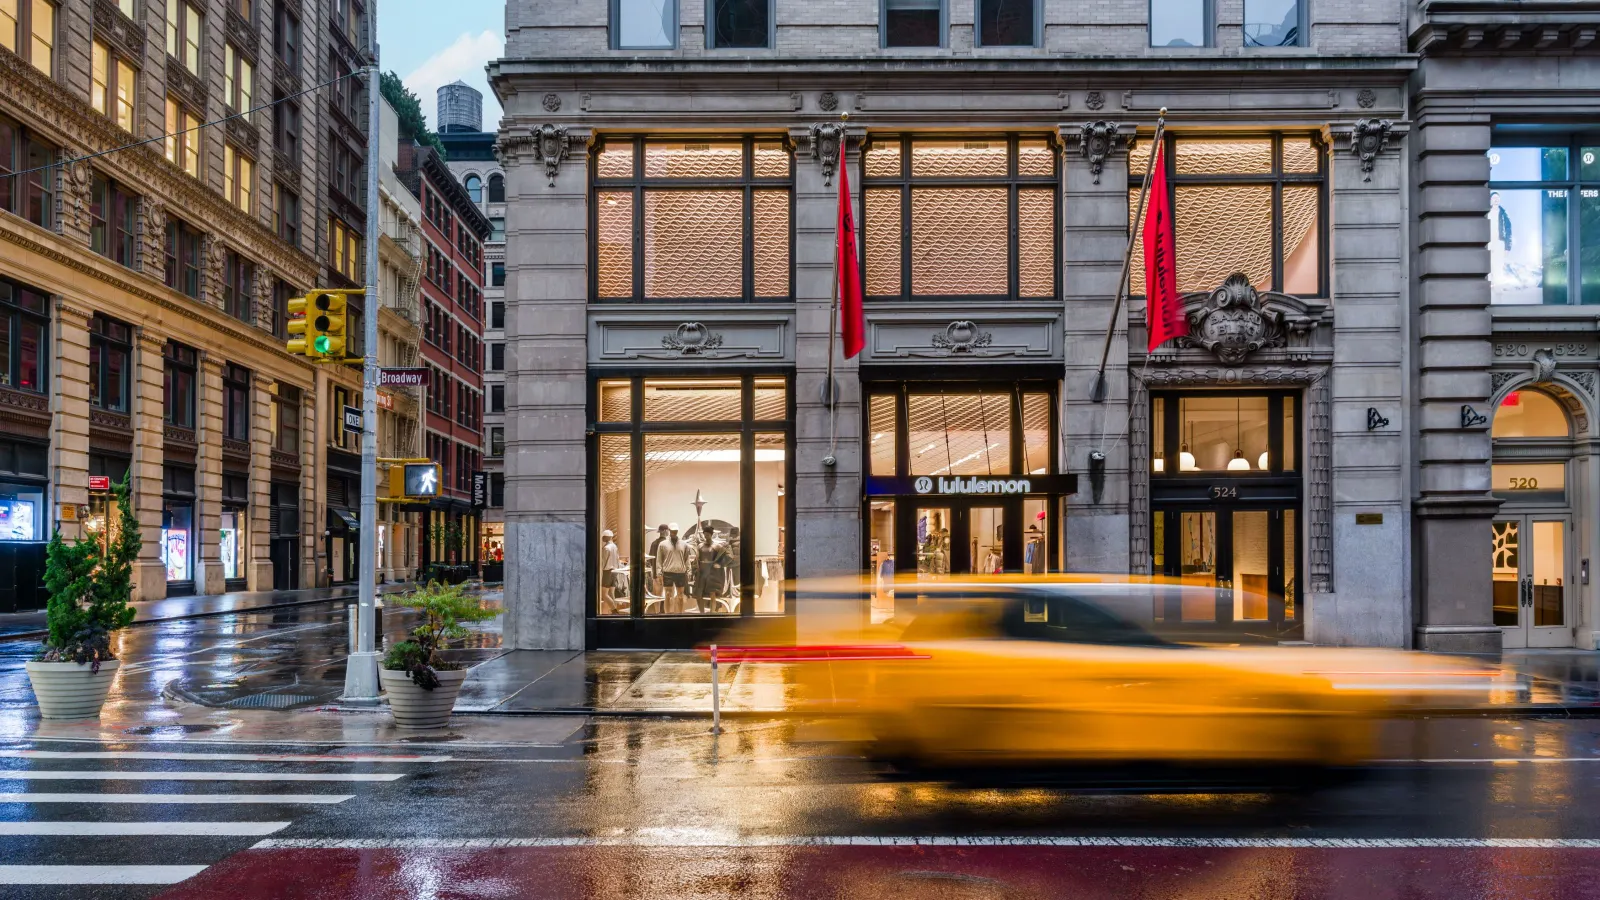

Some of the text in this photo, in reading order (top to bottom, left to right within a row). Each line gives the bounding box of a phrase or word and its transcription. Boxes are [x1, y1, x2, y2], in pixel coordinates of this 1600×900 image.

[1548, 190, 1599, 198] THE FERS
[1209, 310, 1262, 326] BAYARD
[1494, 343, 1588, 357] 520 522
[381, 372, 422, 386] Broadway
[348, 415, 359, 426] ONE
[474, 474, 484, 506] MoMA
[938, 476, 1031, 494] lululemon
[1508, 477, 1539, 490] 520
[1214, 486, 1237, 499] 524
